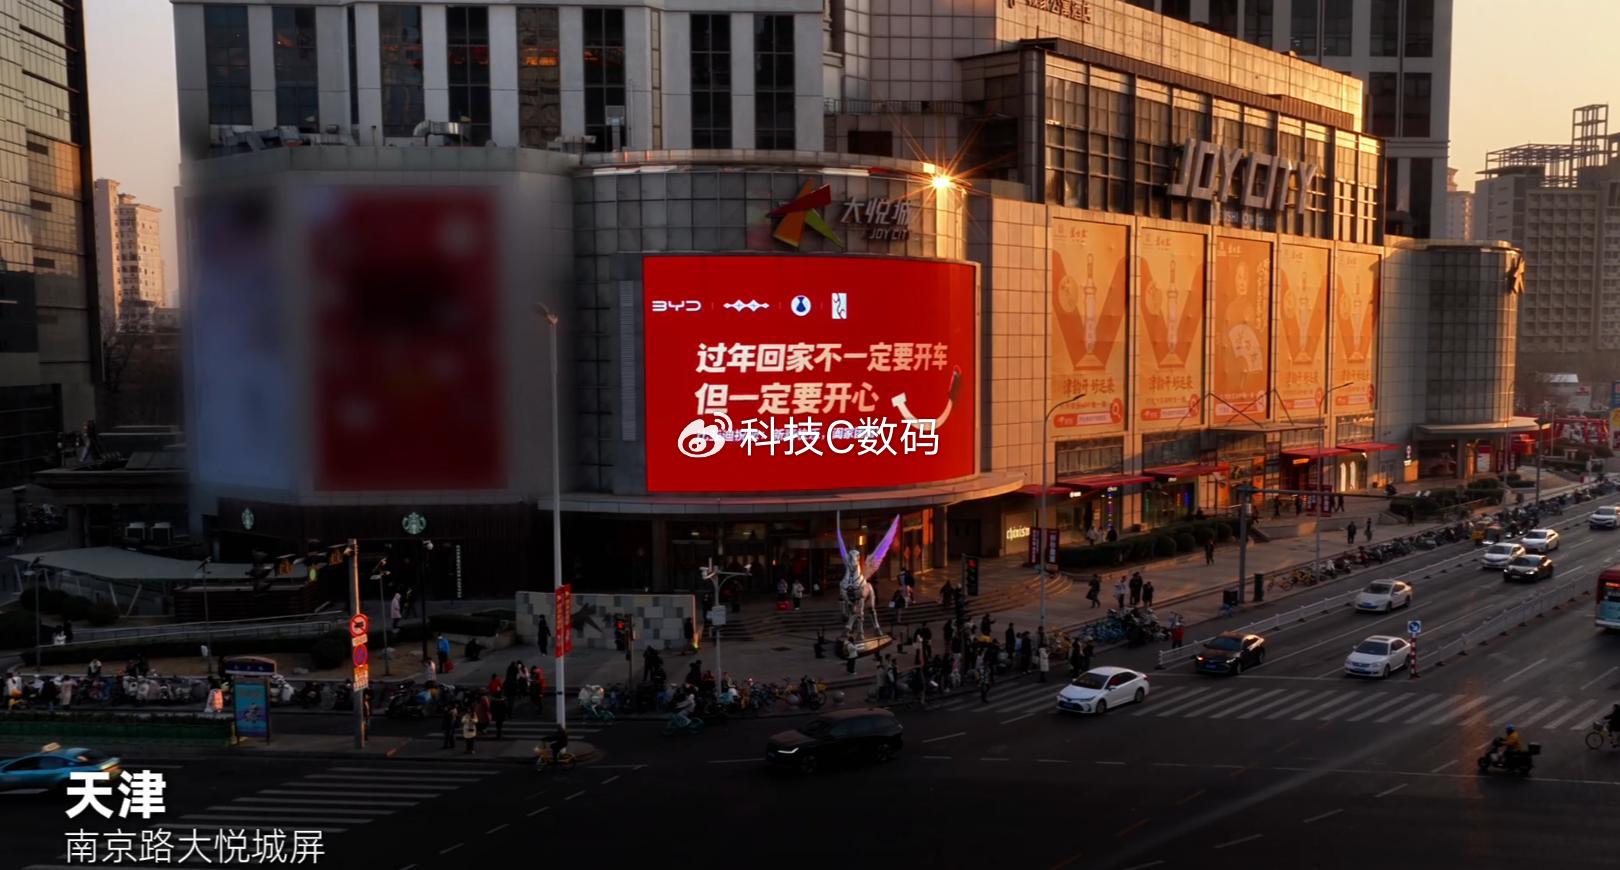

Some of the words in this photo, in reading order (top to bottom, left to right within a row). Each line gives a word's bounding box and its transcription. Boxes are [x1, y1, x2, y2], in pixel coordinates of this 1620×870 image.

[840, 197, 912, 226] 大悦城
[869, 228, 890, 240] JOY
[652, 300, 702, 312] BYD
[696, 342, 949, 373] 过年回家不一定要开车
[695, 382, 880, 415] 但一定要开心
